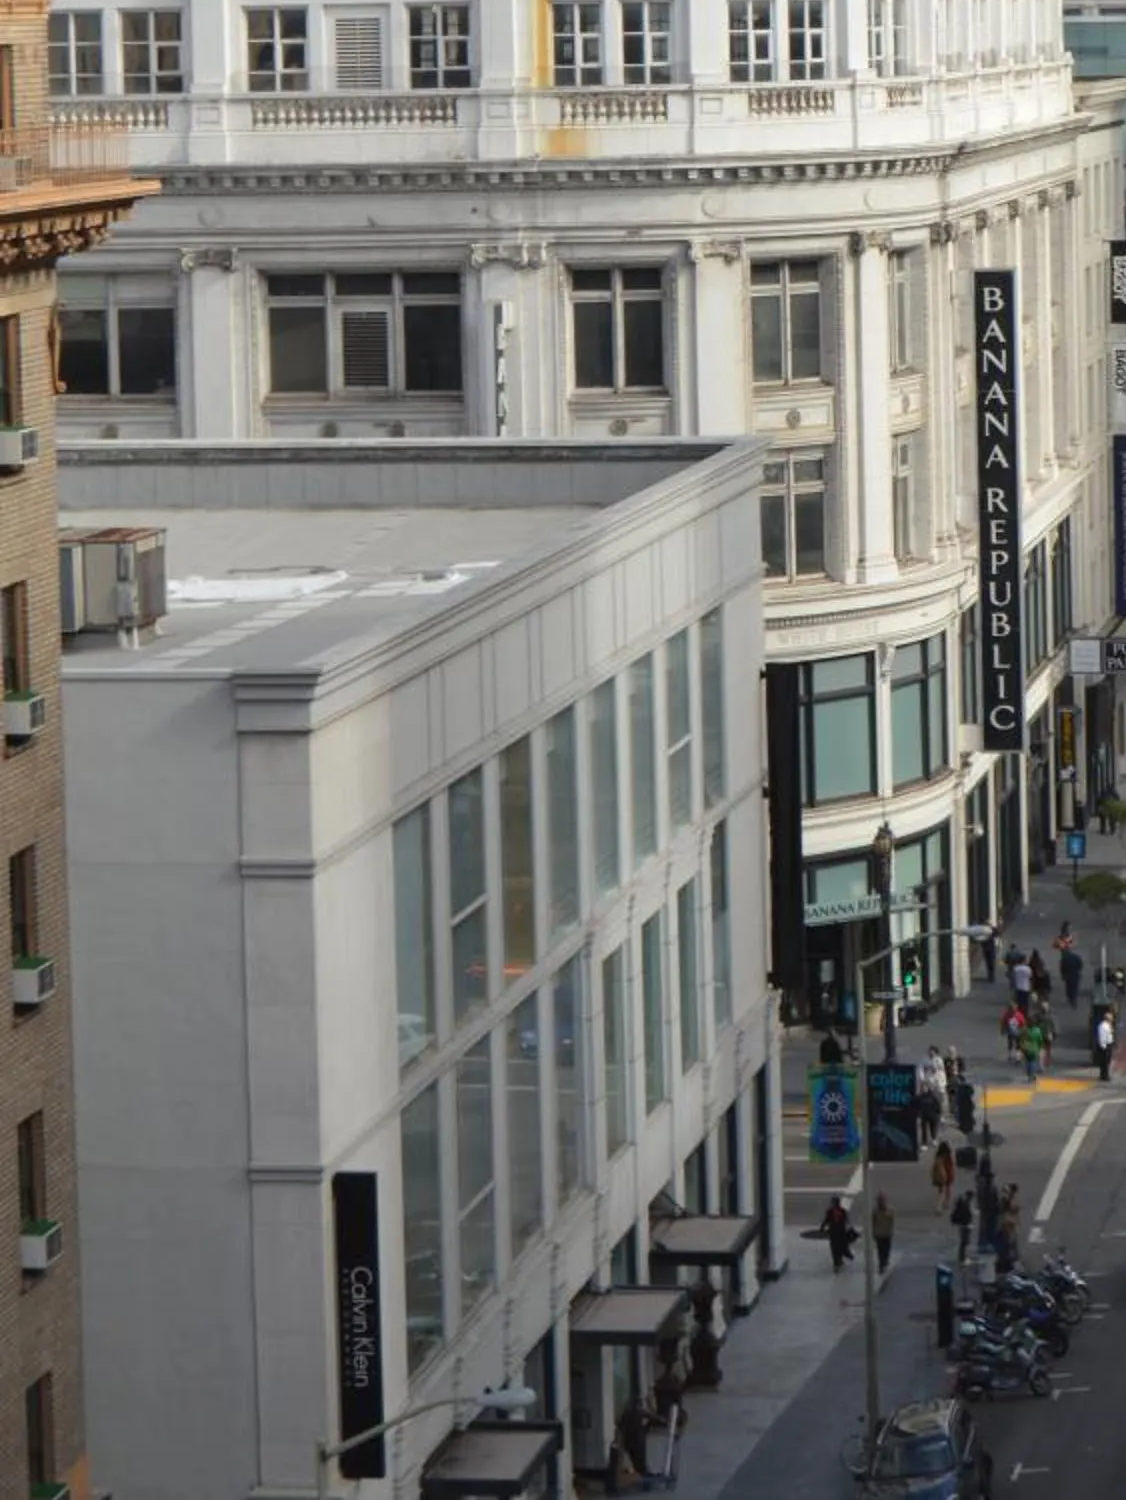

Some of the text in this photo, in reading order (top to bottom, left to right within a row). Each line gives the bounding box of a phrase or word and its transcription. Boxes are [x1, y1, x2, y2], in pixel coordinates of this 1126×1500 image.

[982, 287, 1016, 731] BANANA REPUBLIC
[350, 1266, 376, 1388] Calvin Klein
